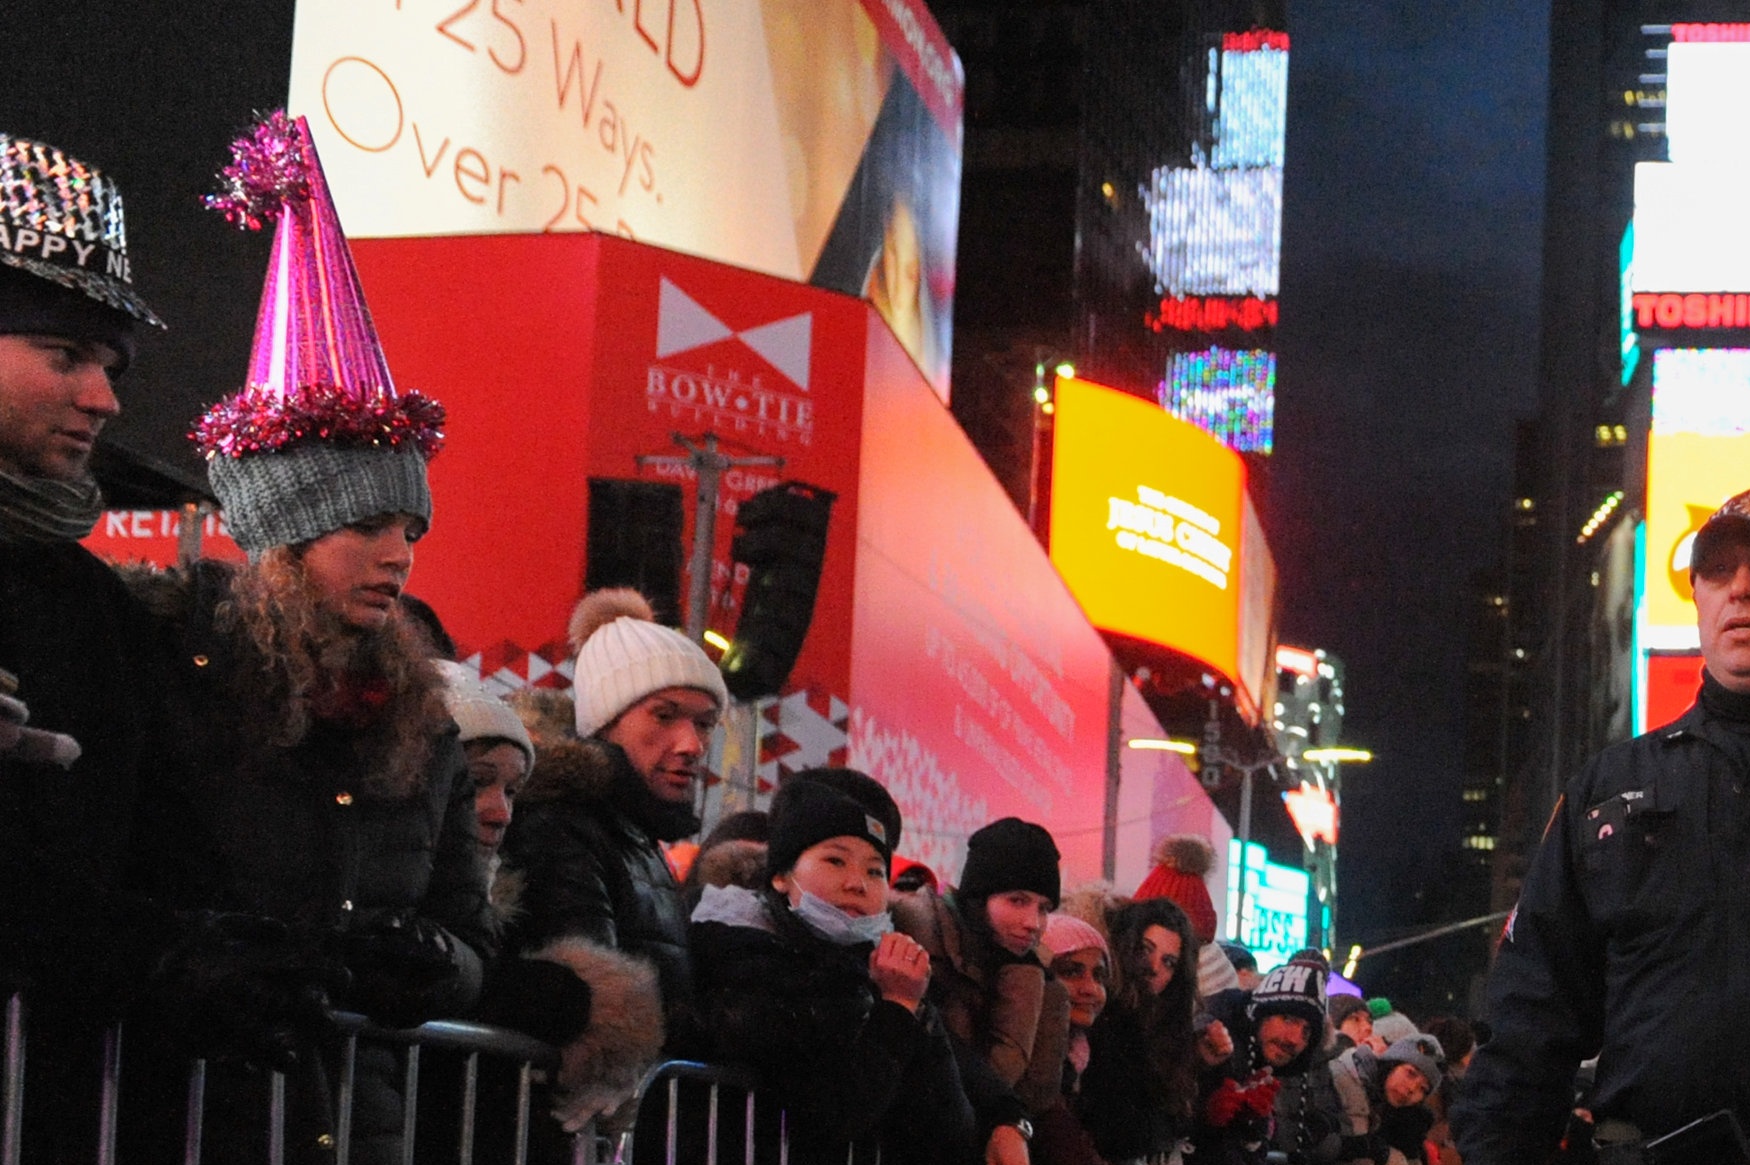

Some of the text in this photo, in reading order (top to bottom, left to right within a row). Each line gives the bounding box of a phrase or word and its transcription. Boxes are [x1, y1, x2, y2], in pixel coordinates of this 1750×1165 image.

[322, 56, 520, 216] Over
[551, 18, 662, 204] Ways.
[0, 224, 133, 284] APPY NE
